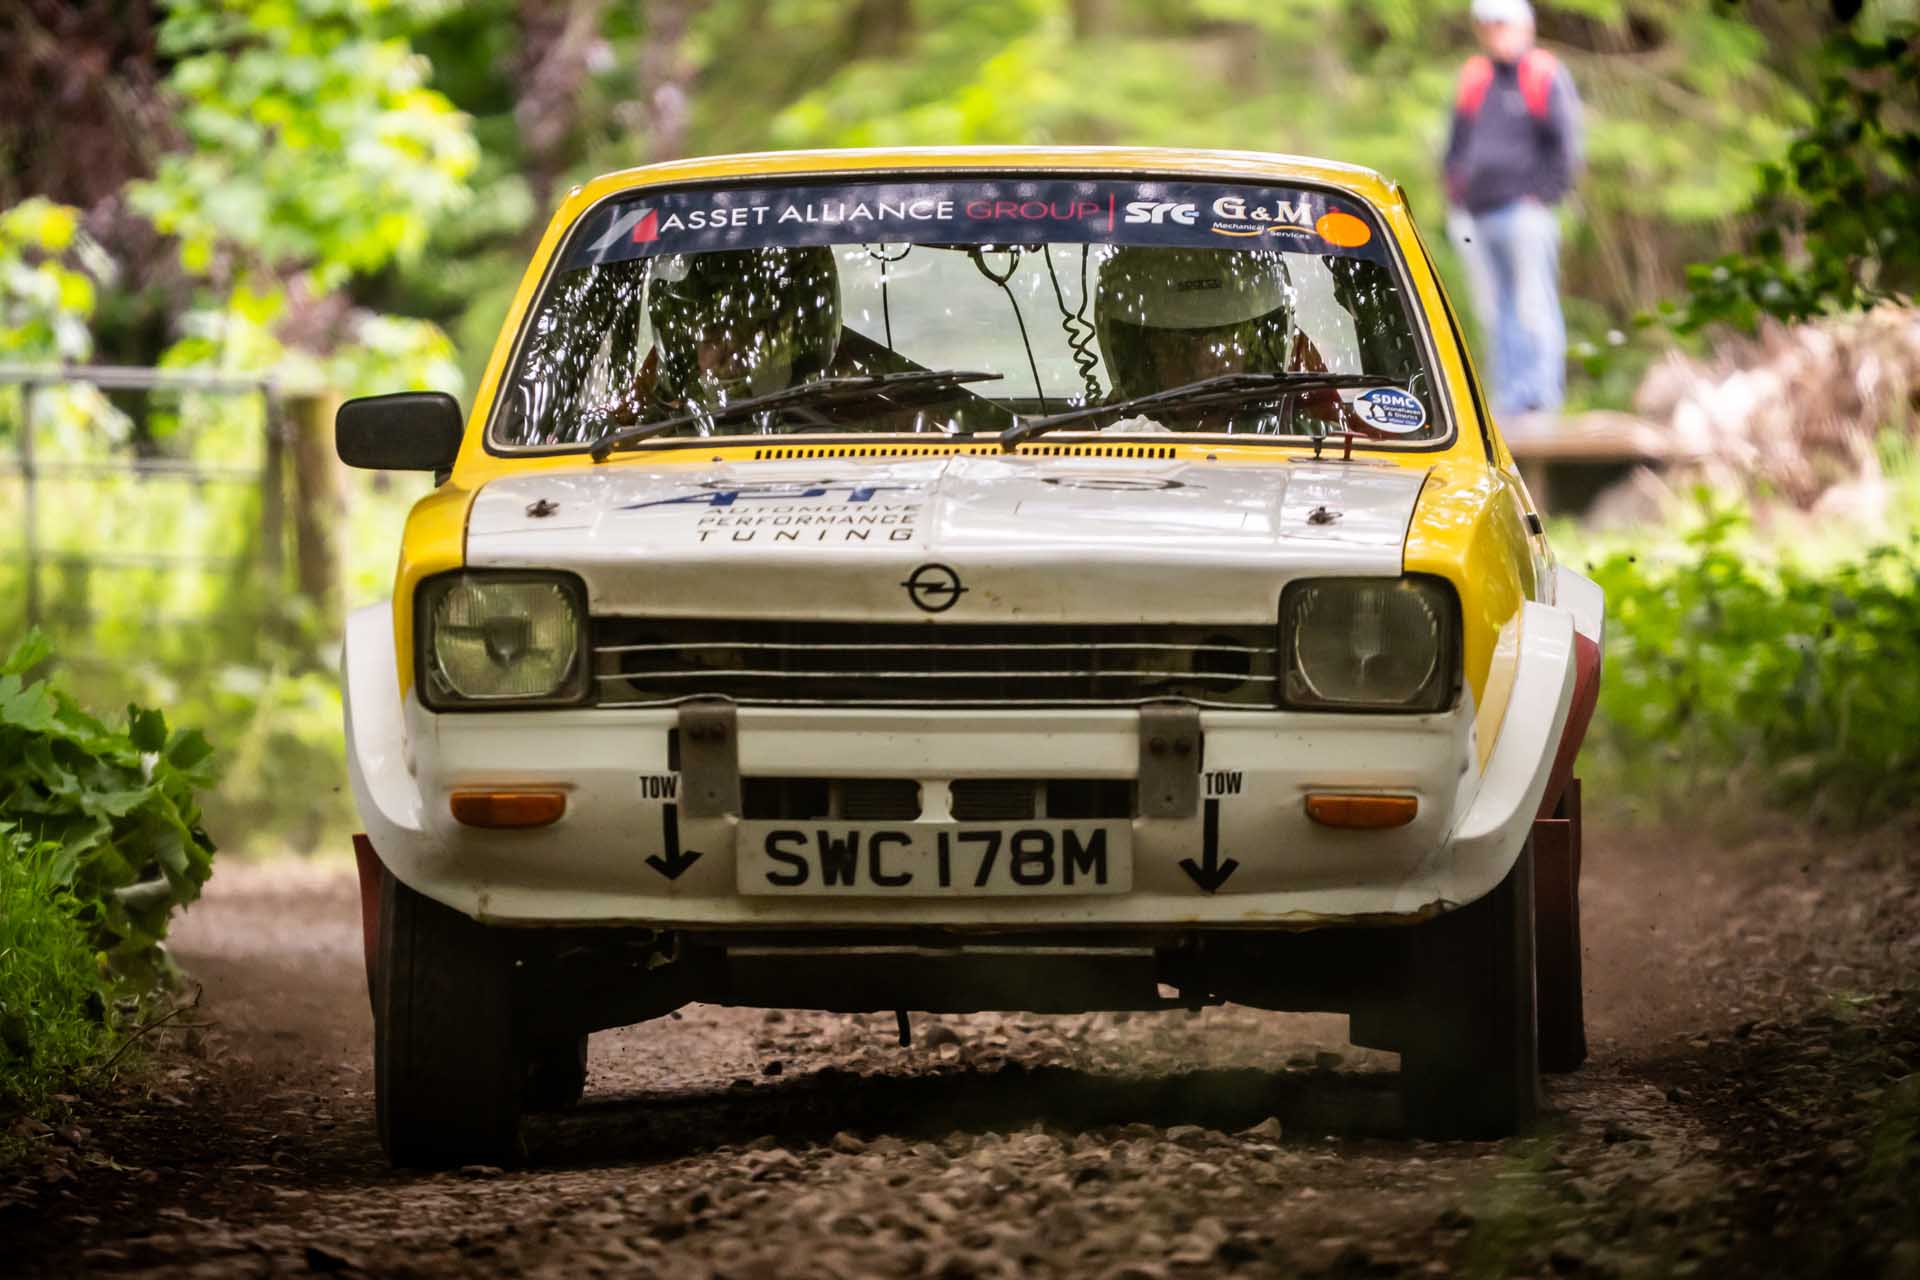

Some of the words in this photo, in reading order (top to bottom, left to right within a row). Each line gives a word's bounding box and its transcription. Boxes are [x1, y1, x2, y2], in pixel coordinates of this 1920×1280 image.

[660, 205, 771, 233] ASSET
[777, 201, 953, 224] ALLIANCE
[965, 199, 1099, 221] GROUP
[1371, 393, 1415, 409] SDMC
[703, 503, 923, 514] AUTOMOTIVE
[697, 514, 918, 526] PERFORMANCE
[697, 528, 915, 542] TUNING
[640, 775, 678, 799] TOW
[1205, 771, 1243, 796] TOW
[764, 829, 913, 888] SWC
[936, 828, 1108, 888] 178M
